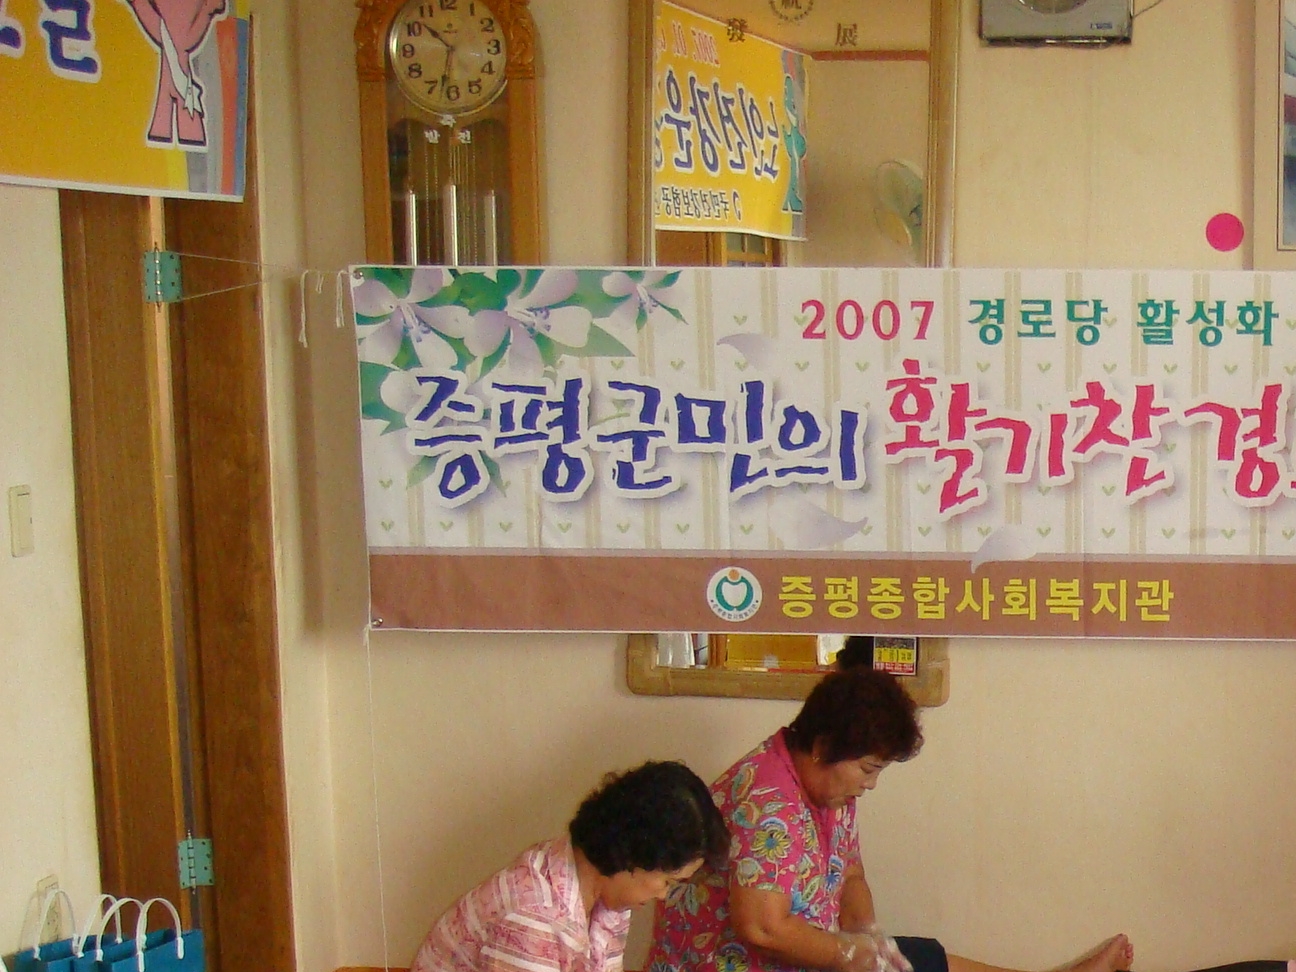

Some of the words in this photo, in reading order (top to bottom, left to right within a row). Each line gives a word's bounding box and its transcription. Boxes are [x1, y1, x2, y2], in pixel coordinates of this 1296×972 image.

[419, 5, 433, 17] 11
[440, 0, 457, 10] 12
[407, 21, 422, 36] 10
[480, 18, 495, 33] 2
[402, 44, 414, 58] 9
[487, 39, 500, 55] 3
[408, 63, 422, 79] 8
[481, 61, 495, 75] 4
[424, 80, 438, 95] 7
[446, 85, 460, 101] 6
[468, 78, 482, 95] 5
[801, 299, 935, 340] 2007
[969, 299, 1108, 346] 경로당
[1137, 299, 1279, 348] 활성화
[413, 375, 860, 501] 증평군민의
[884, 357, 1172, 514] 활기찬
[778, 575, 1174, 622] 증평종합사회복지관
